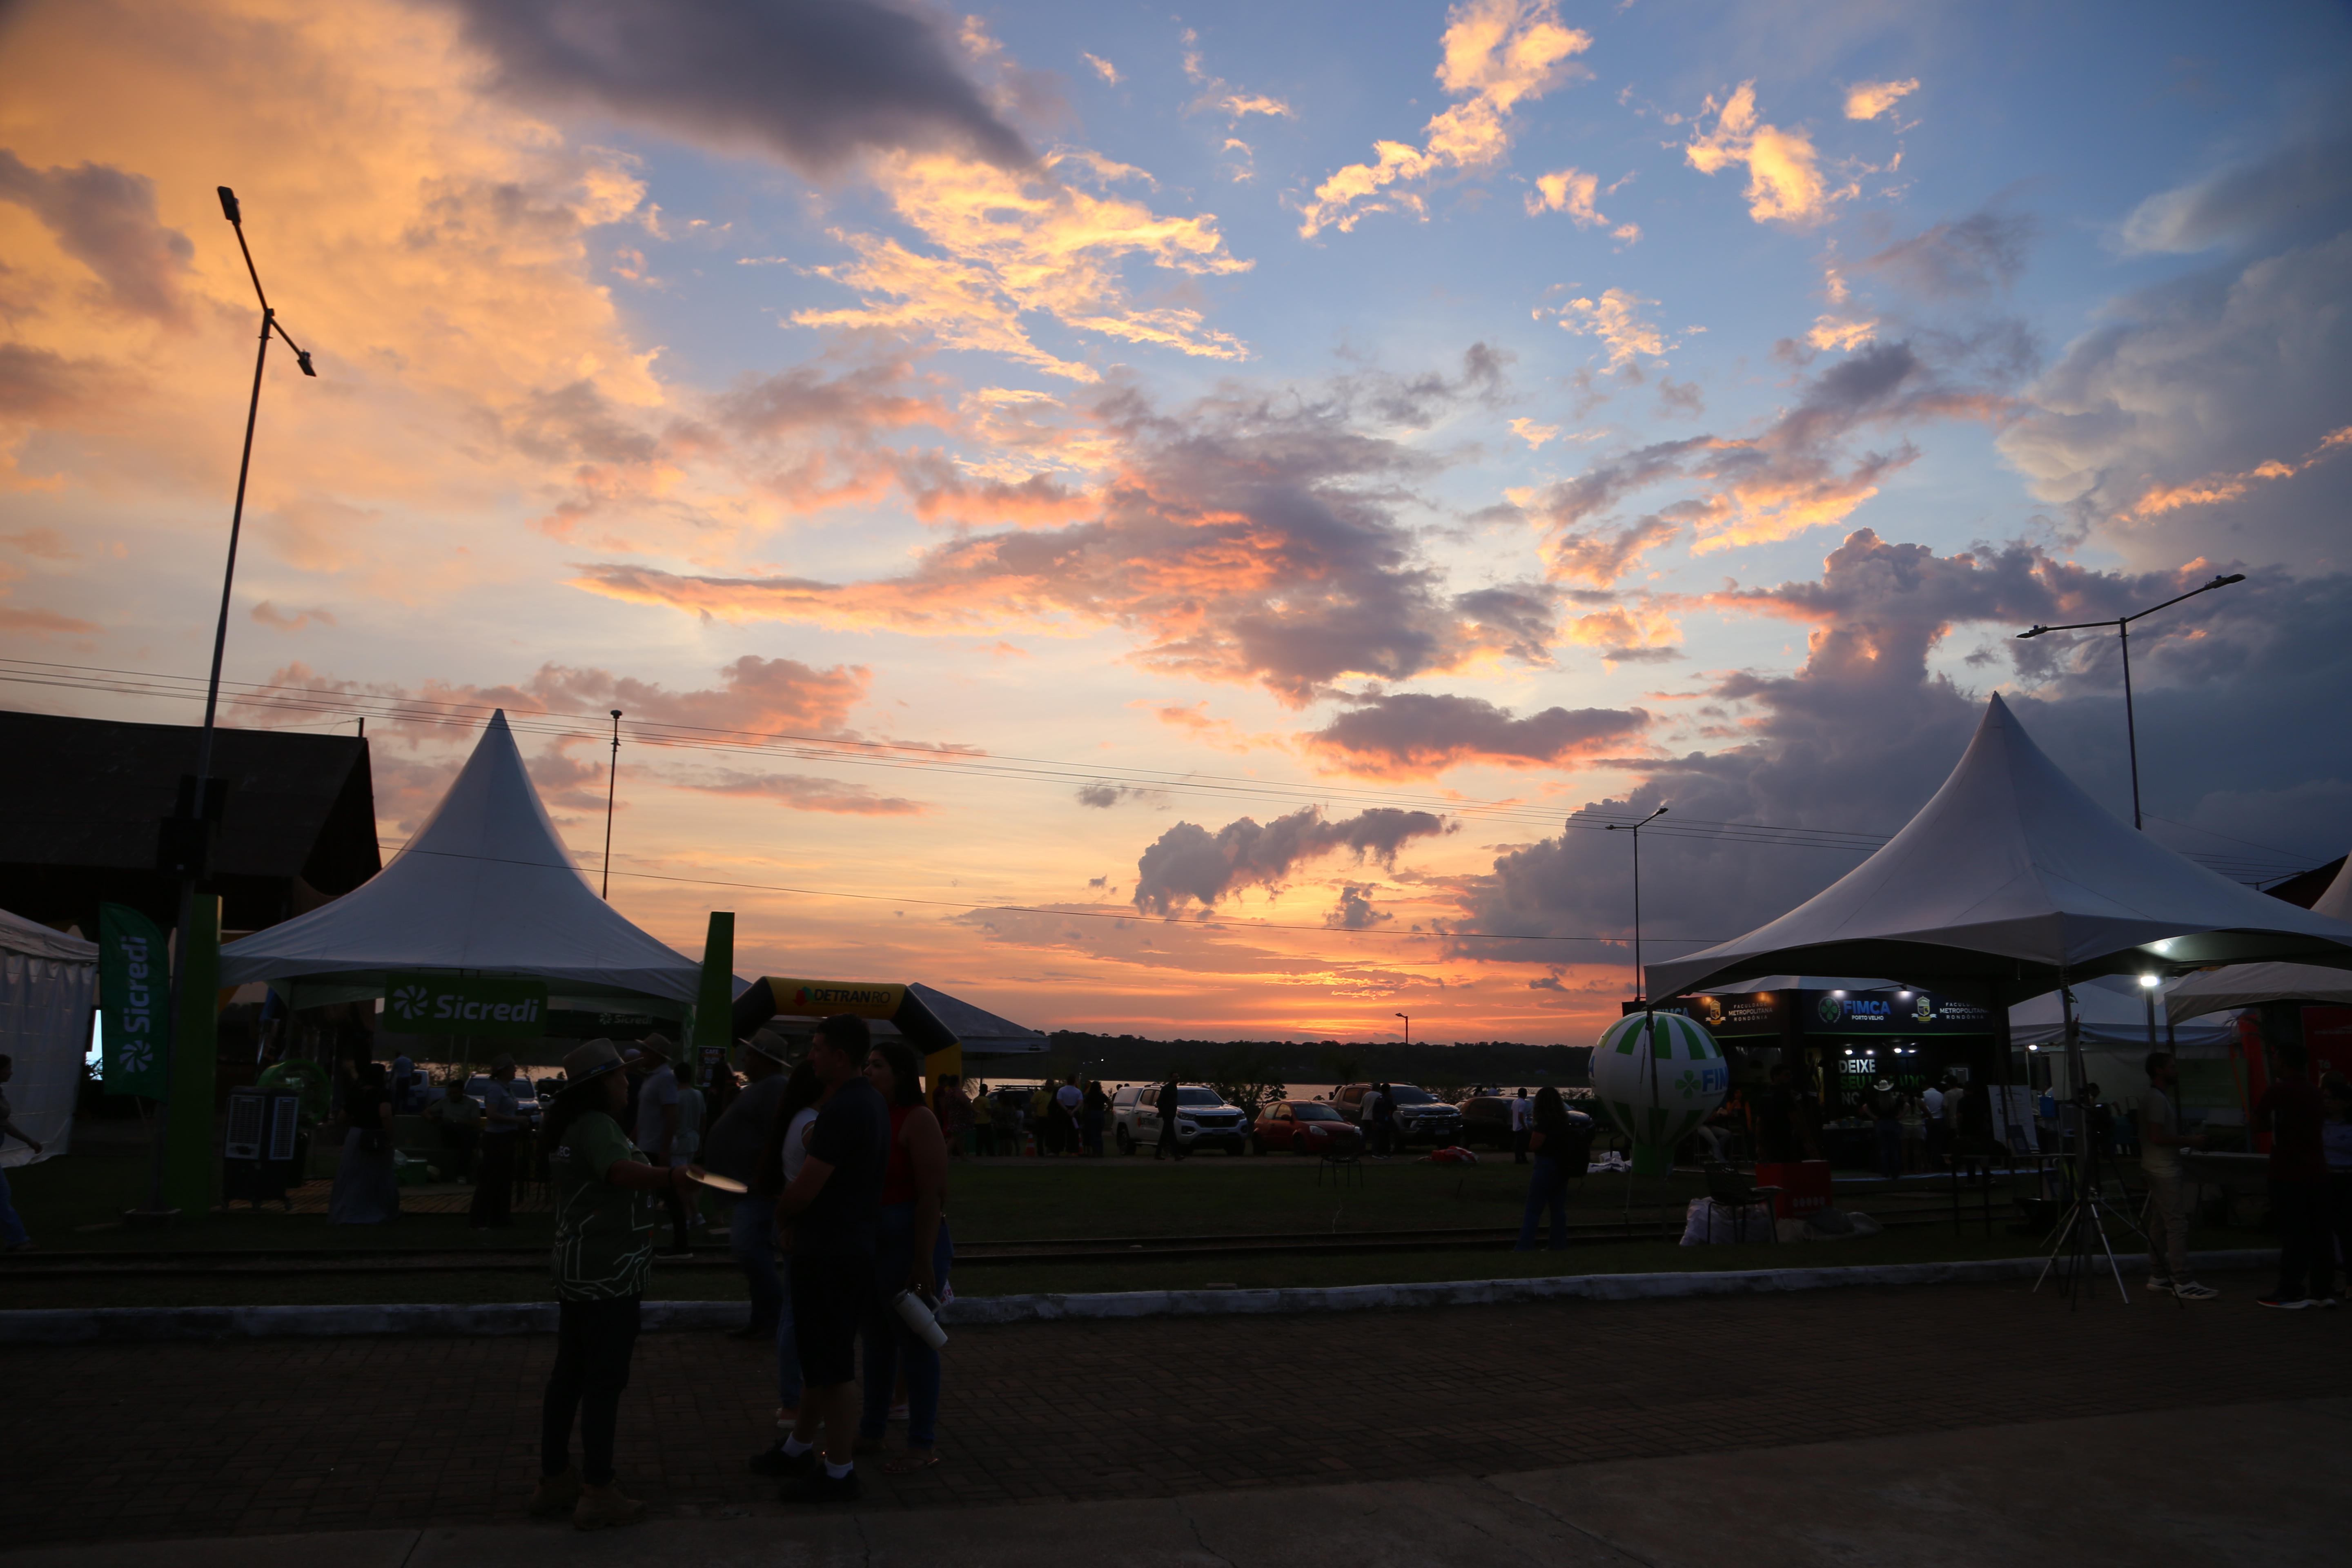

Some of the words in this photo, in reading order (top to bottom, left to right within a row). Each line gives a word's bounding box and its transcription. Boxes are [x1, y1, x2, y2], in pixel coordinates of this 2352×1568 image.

[121, 936, 150, 1033] Sicredi
[433, 995, 539, 1022] Sicredi
[1728, 1007, 1773, 1016] METROPOLITANA
[1843, 1000, 1891, 1015] FIMCA
[614, 1015, 653, 1024] Sicredi
[1838, 1059, 1876, 1074] DEIXE
[1840, 1076, 1866, 1089] SEU
